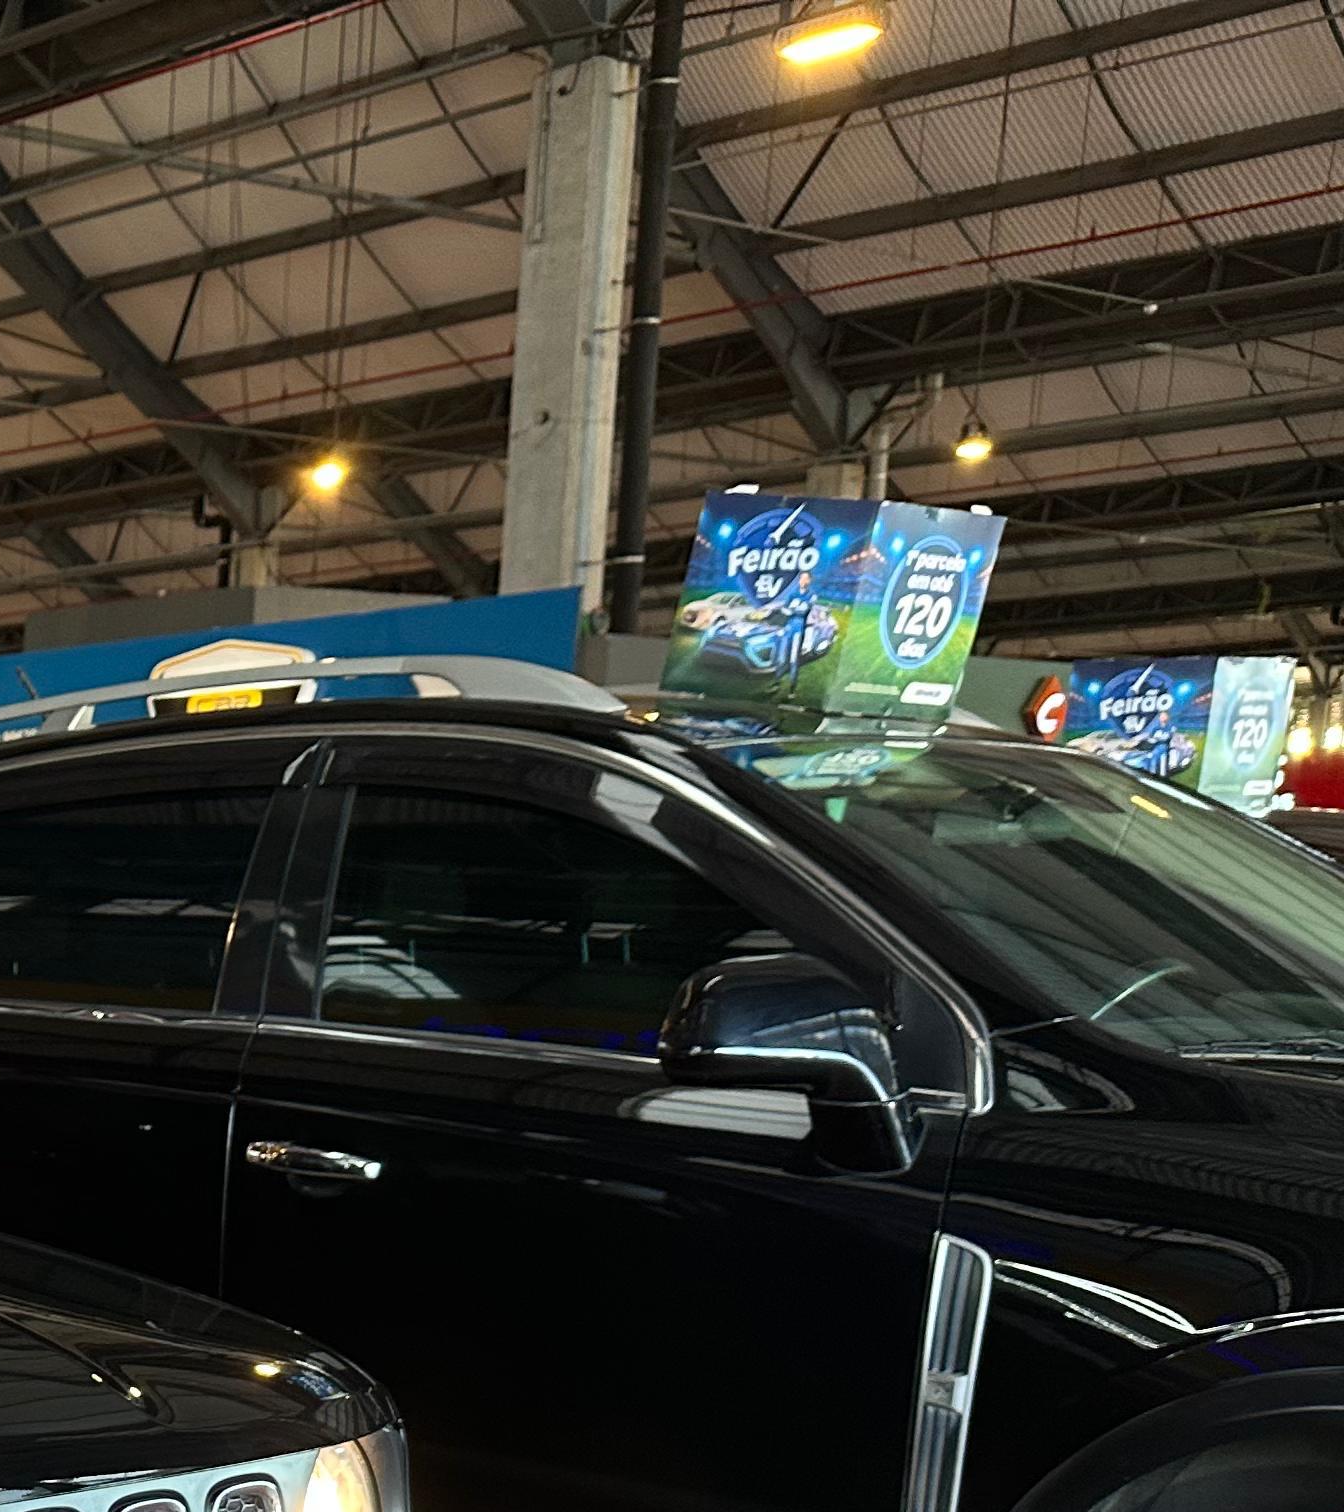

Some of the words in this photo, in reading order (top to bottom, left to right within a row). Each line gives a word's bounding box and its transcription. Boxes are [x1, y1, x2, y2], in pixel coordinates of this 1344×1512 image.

[727, 539, 820, 577] Feirão
[914, 553, 967, 573] parcela
[893, 593, 953, 638] 120
[1099, 689, 1174, 721] Feirão
[1232, 718, 1269, 750] 120
